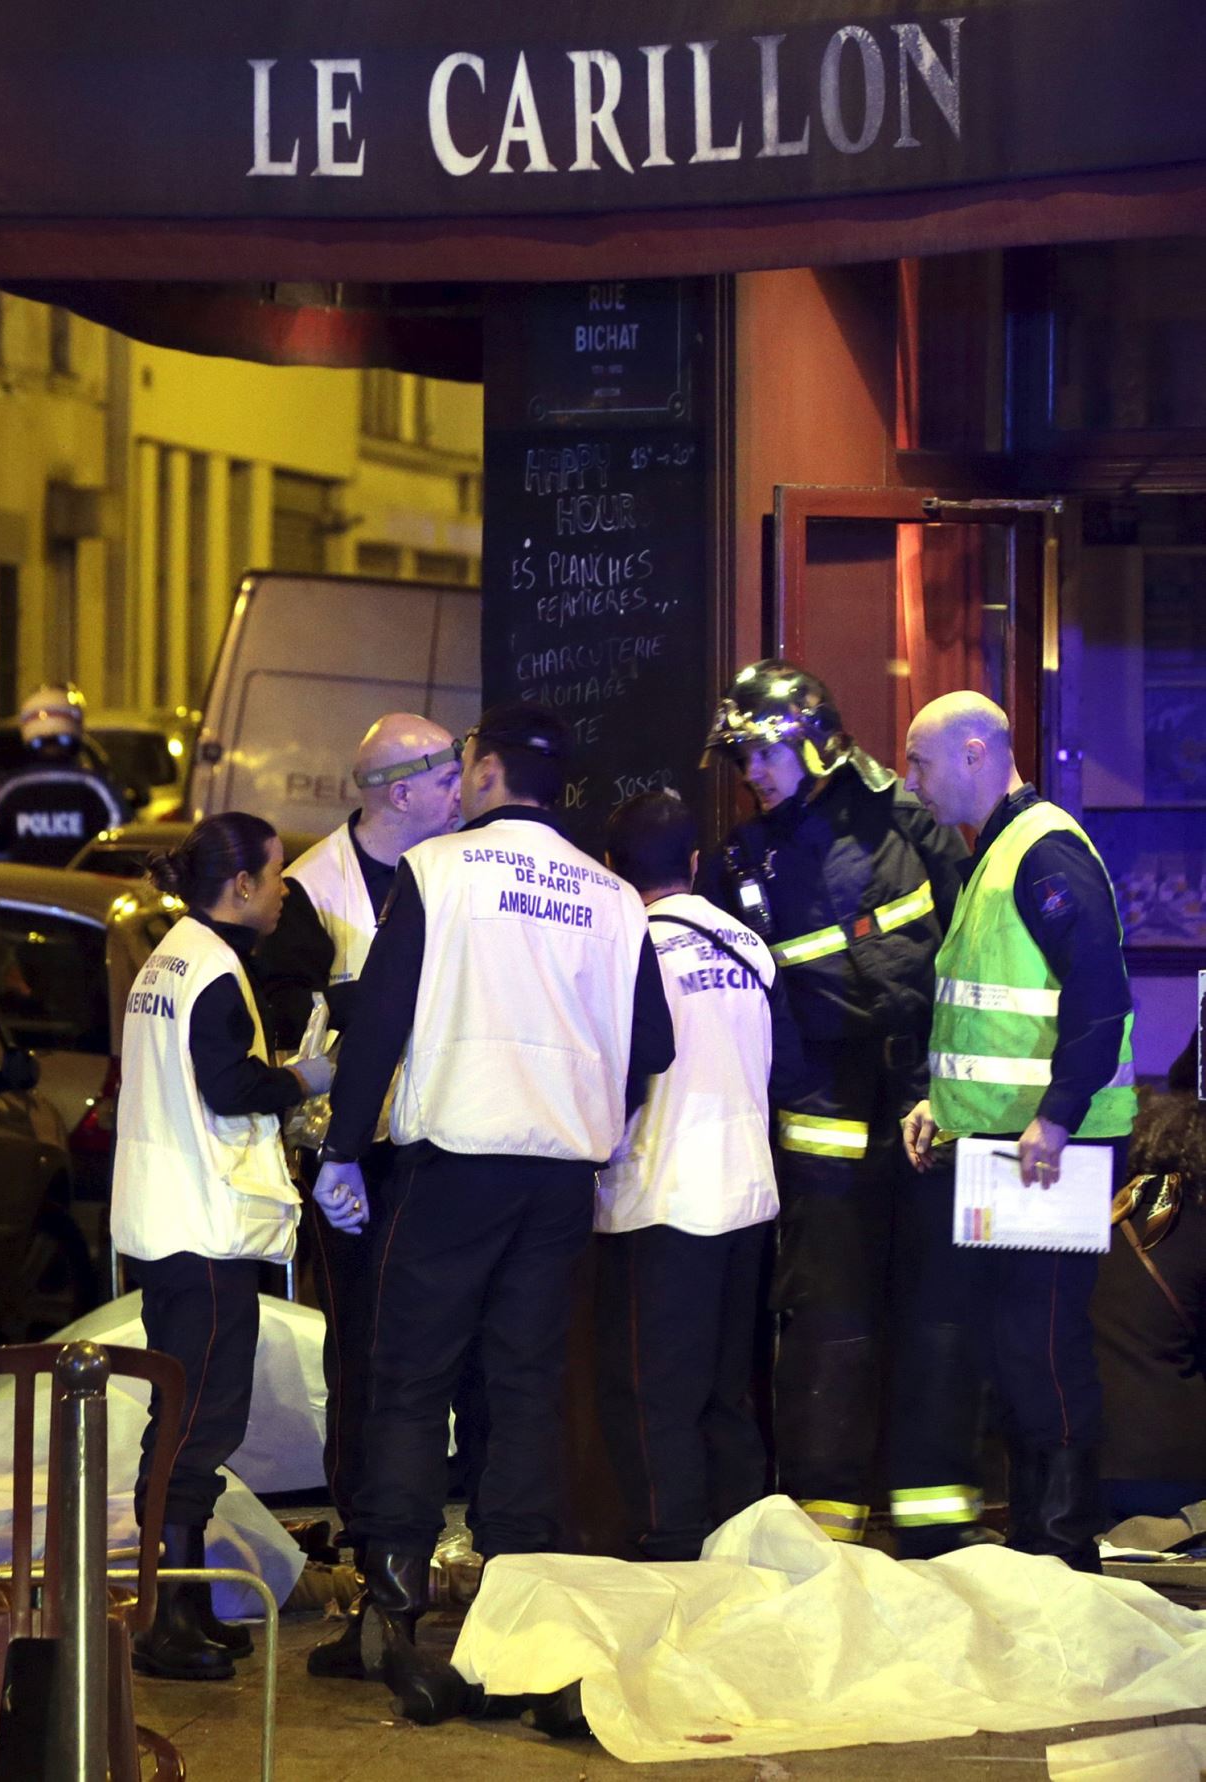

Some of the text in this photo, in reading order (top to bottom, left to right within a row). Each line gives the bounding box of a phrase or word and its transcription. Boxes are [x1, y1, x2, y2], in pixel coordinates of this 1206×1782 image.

[246, 18, 966, 177] LE CARILLON
[588, 284, 627, 311] RUE
[574, 324, 640, 352] BICHAT
[525, 443, 611, 496] HAPPY
[556, 492, 636, 536] HOUR
[548, 549, 654, 588] PLANCHES
[516, 634, 666, 681] CHARCUTERIE
[16, 811, 84, 838] POLICE
[463, 849, 621, 891] SAPEURS POMPIERS
[515, 868, 580, 895] DE PARIS
[498, 890, 592, 929] AMBULANCIER
